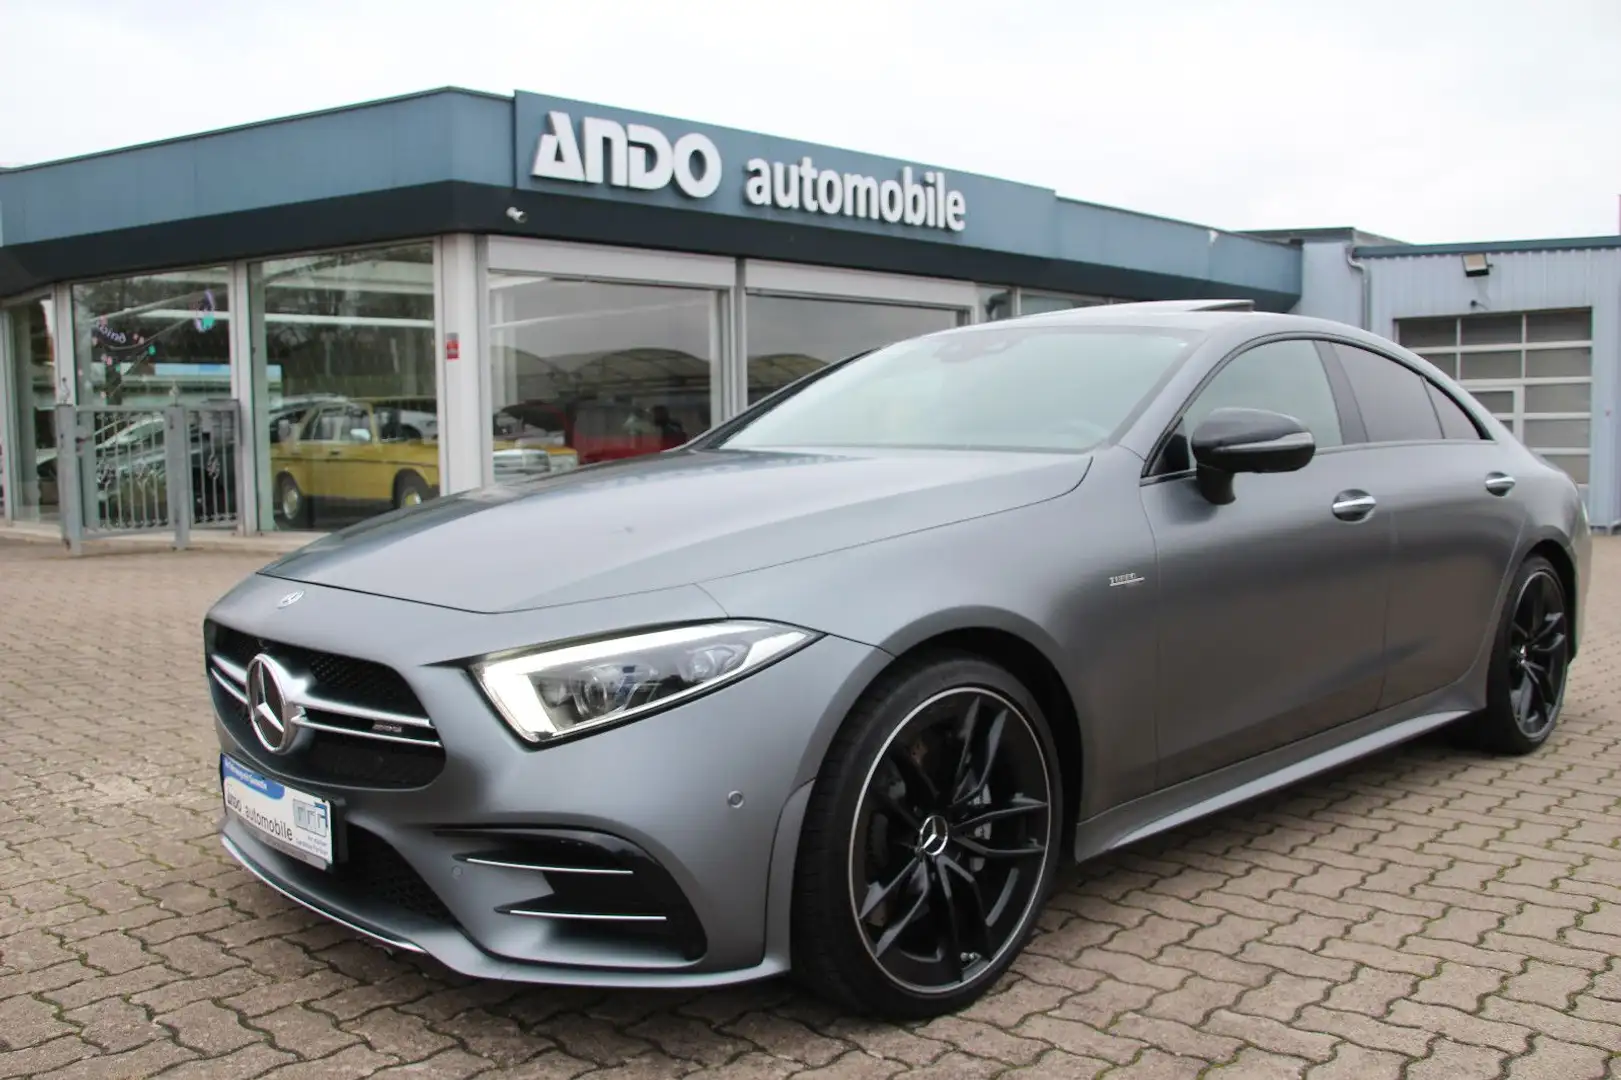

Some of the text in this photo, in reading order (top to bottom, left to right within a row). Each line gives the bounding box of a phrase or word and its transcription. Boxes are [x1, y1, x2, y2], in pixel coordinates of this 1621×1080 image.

[532, 110, 966, 232] ANDO automobile
[244, 805, 293, 841] automobile
